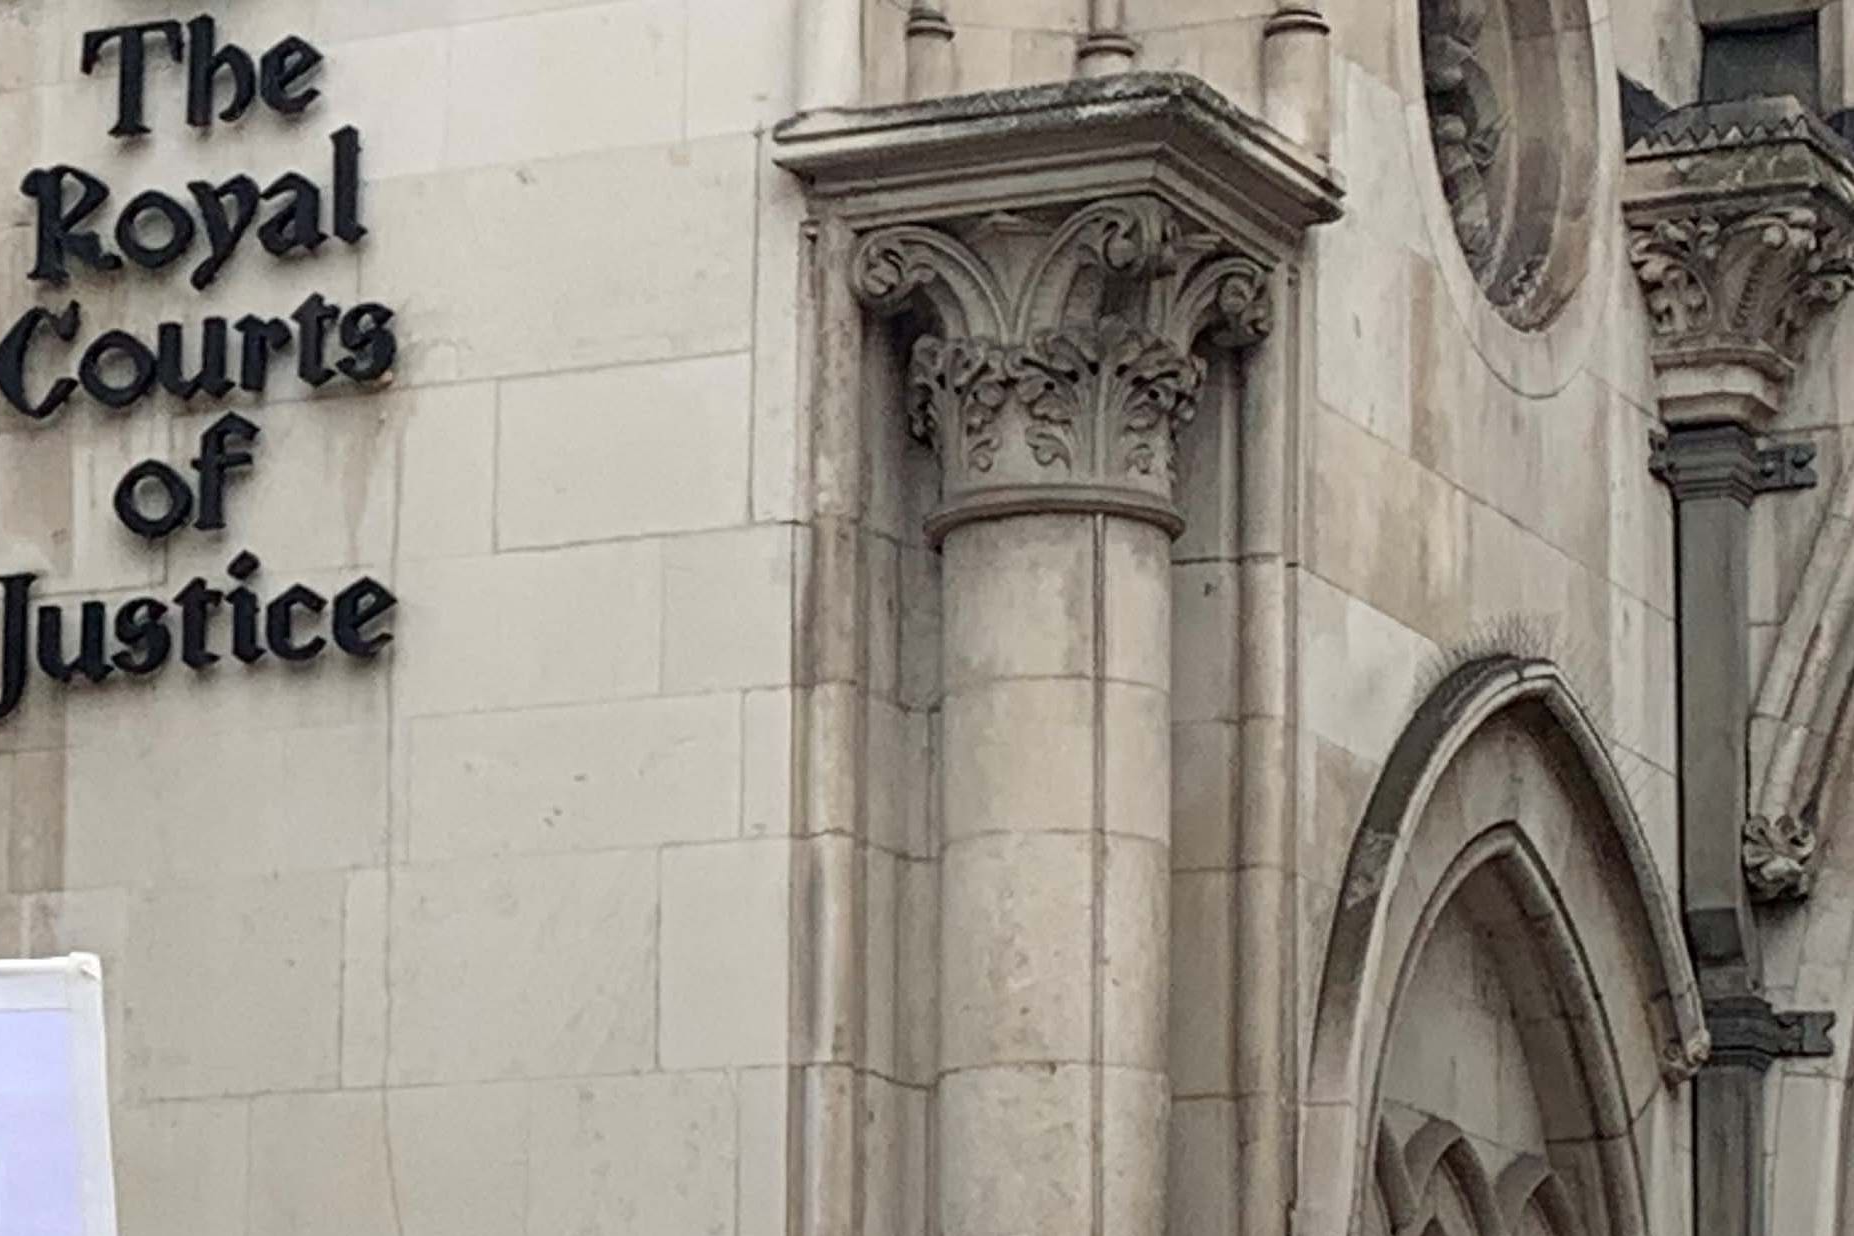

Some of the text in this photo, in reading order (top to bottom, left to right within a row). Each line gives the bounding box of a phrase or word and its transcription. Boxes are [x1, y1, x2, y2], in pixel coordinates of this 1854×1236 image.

[81, 14, 324, 138] The
[21, 126, 368, 290] Royal
[114, 411, 260, 538] of
